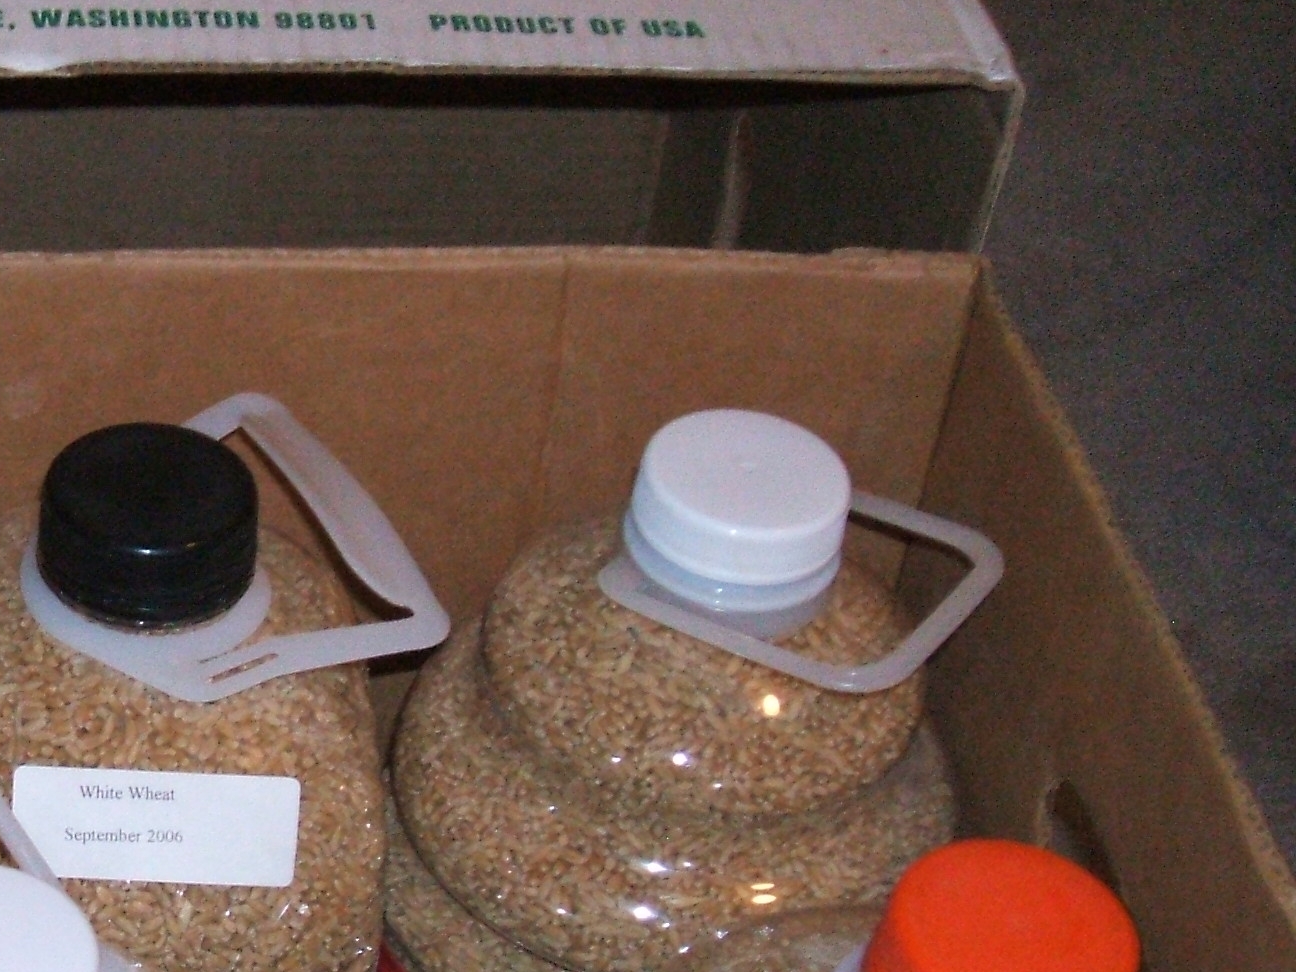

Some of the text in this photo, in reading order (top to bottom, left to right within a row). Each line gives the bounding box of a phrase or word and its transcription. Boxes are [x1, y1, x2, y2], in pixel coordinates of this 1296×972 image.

[30, 9, 261, 29] WASHINGTON
[274, 12, 378, 31] 98801
[428, 14, 577, 35] PRODUCT
[588, 18, 628, 36] OF
[639, 18, 707, 38] USA
[79, 784, 176, 801] White Wheat
[63, 826, 184, 846] September 2006
